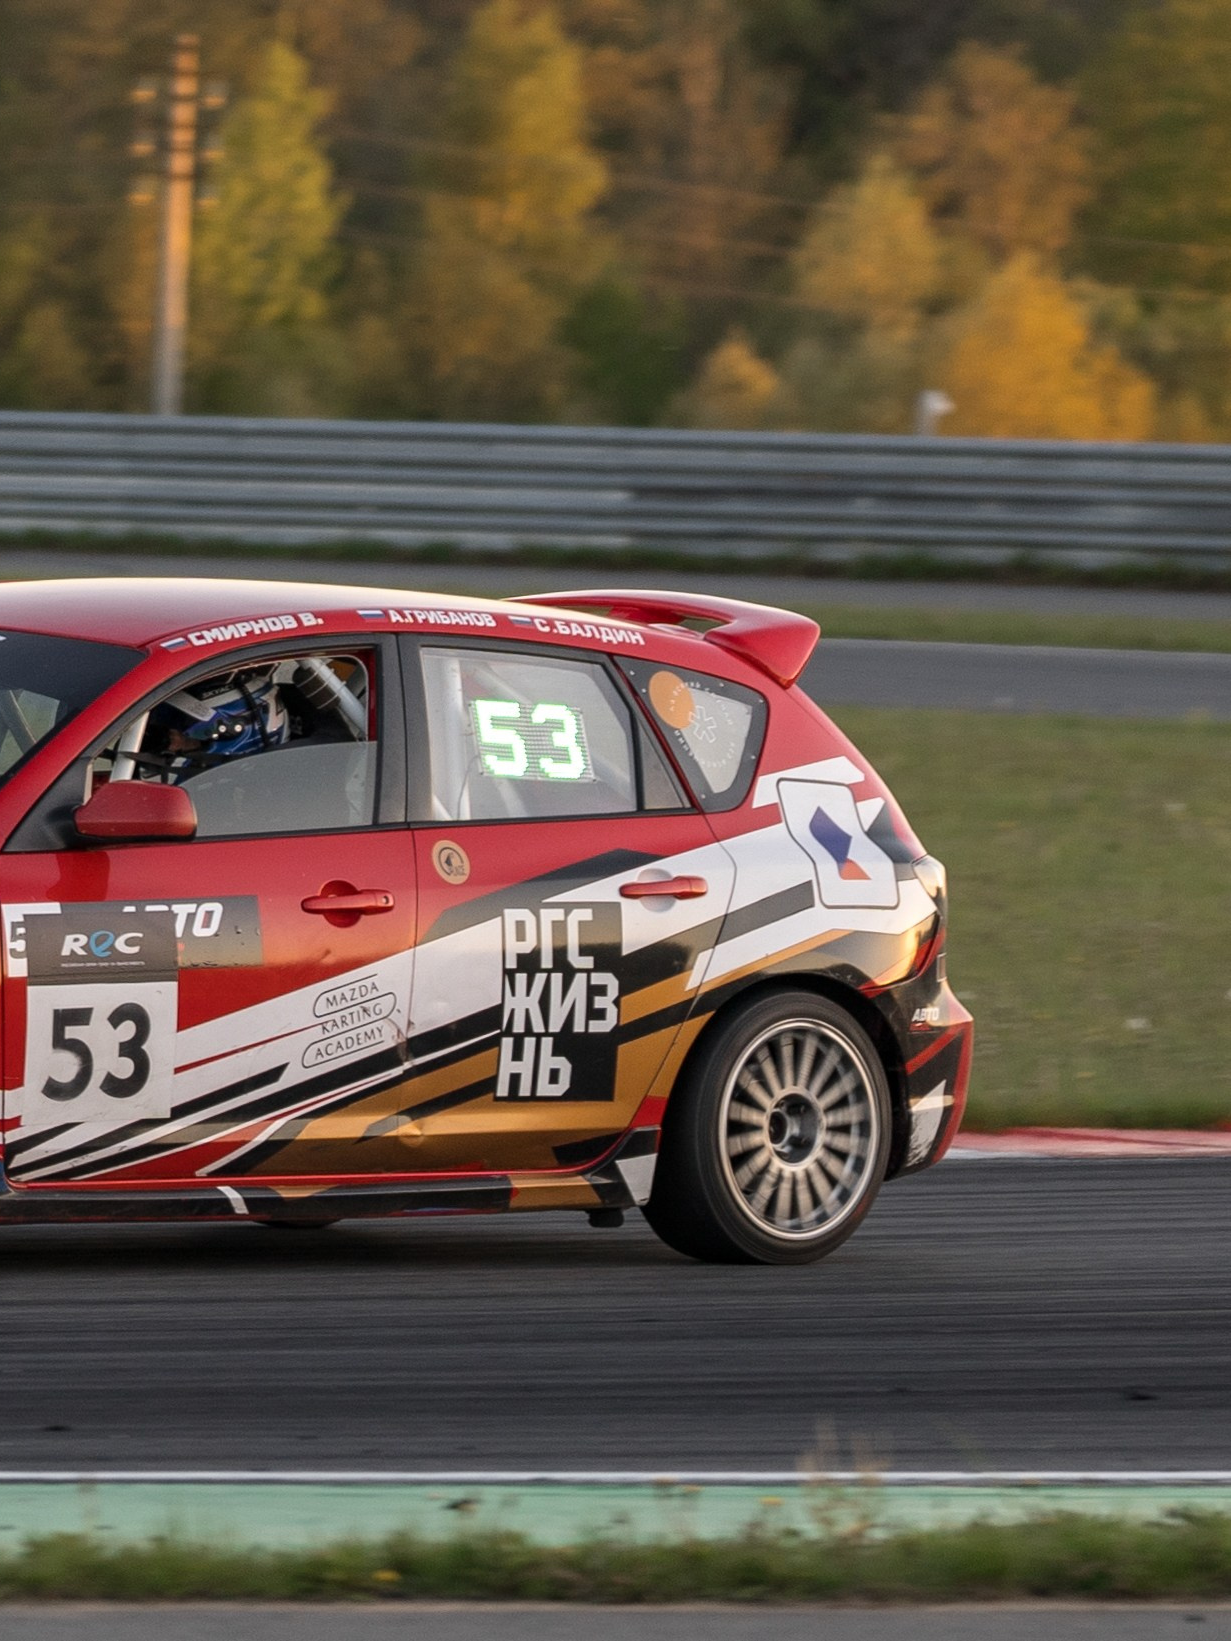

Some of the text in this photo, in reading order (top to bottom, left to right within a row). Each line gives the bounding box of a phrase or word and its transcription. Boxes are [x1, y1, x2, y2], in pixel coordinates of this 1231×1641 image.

[188, 612, 323, 646] СМИРНОВ В.
[388, 609, 497, 628] А.ГРИБАНОВ
[474, 699, 585, 780] 53
[503, 908, 594, 969] РГС
[325, 980, 380, 1009] MAZDA
[501, 972, 619, 1033] ЖИЗ
[321, 1002, 384, 1035] KARTING
[41, 1002, 152, 1102] 53
[314, 1026, 386, 1061] ACADEMY
[496, 1037, 573, 1097] НЬ
